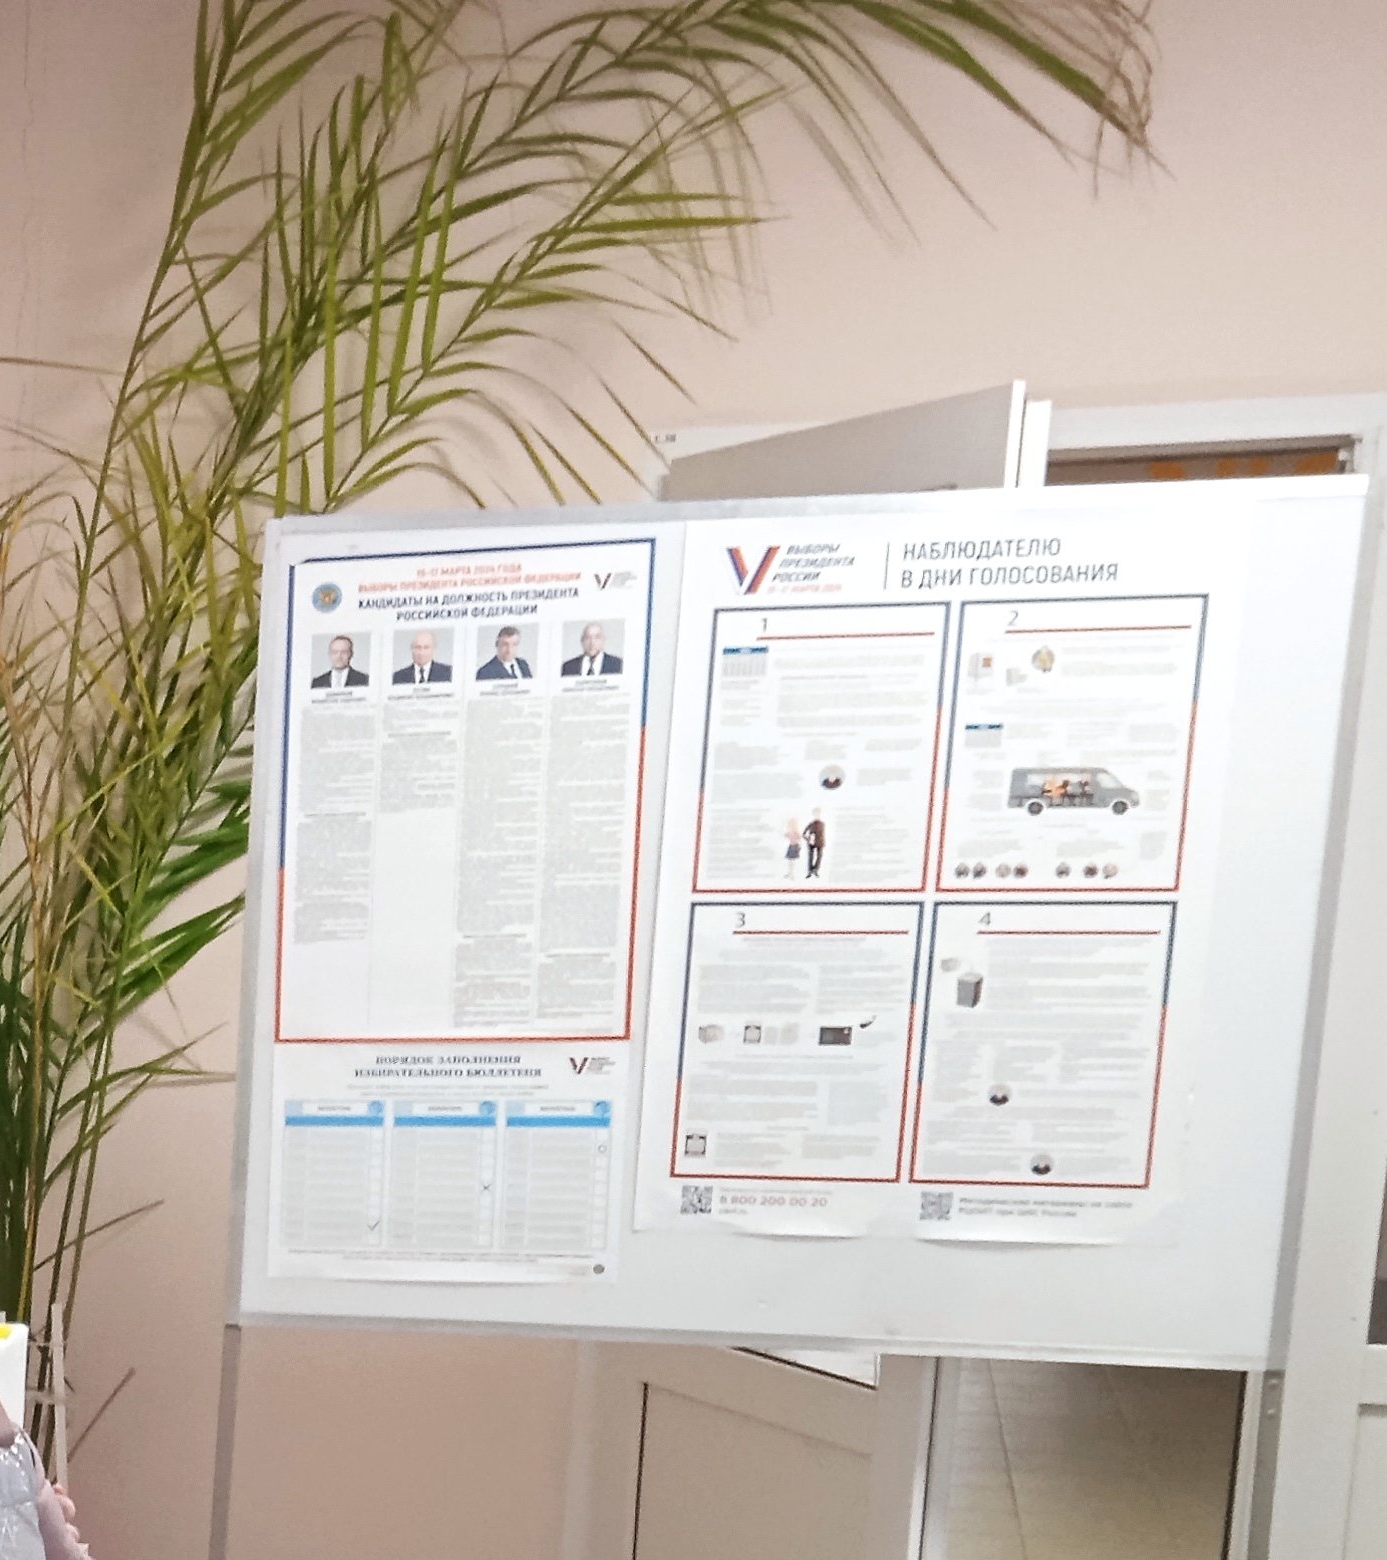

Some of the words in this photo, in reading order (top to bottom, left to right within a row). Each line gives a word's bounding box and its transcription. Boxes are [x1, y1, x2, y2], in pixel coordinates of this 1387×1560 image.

[786, 543, 841, 555] ВЫБОРЫ
[902, 537, 1062, 561] НАБЛЮДАТЕЛЮ
[900, 569, 913, 589] В
[918, 568, 962, 590] ДНИ
[969, 563, 1119, 586] ГОЛОСОВАНИЯ
[358, 595, 423, 610] КАНДИДАТЫ
[425, 595, 439, 606] НА
[510, 586, 579, 601] ПРЕЗИДЕНТА
[761, 617, 768, 633] 1
[1007, 609, 1020, 627] 2
[735, 911, 747, 928] 3
[978, 911, 992, 927] 4
